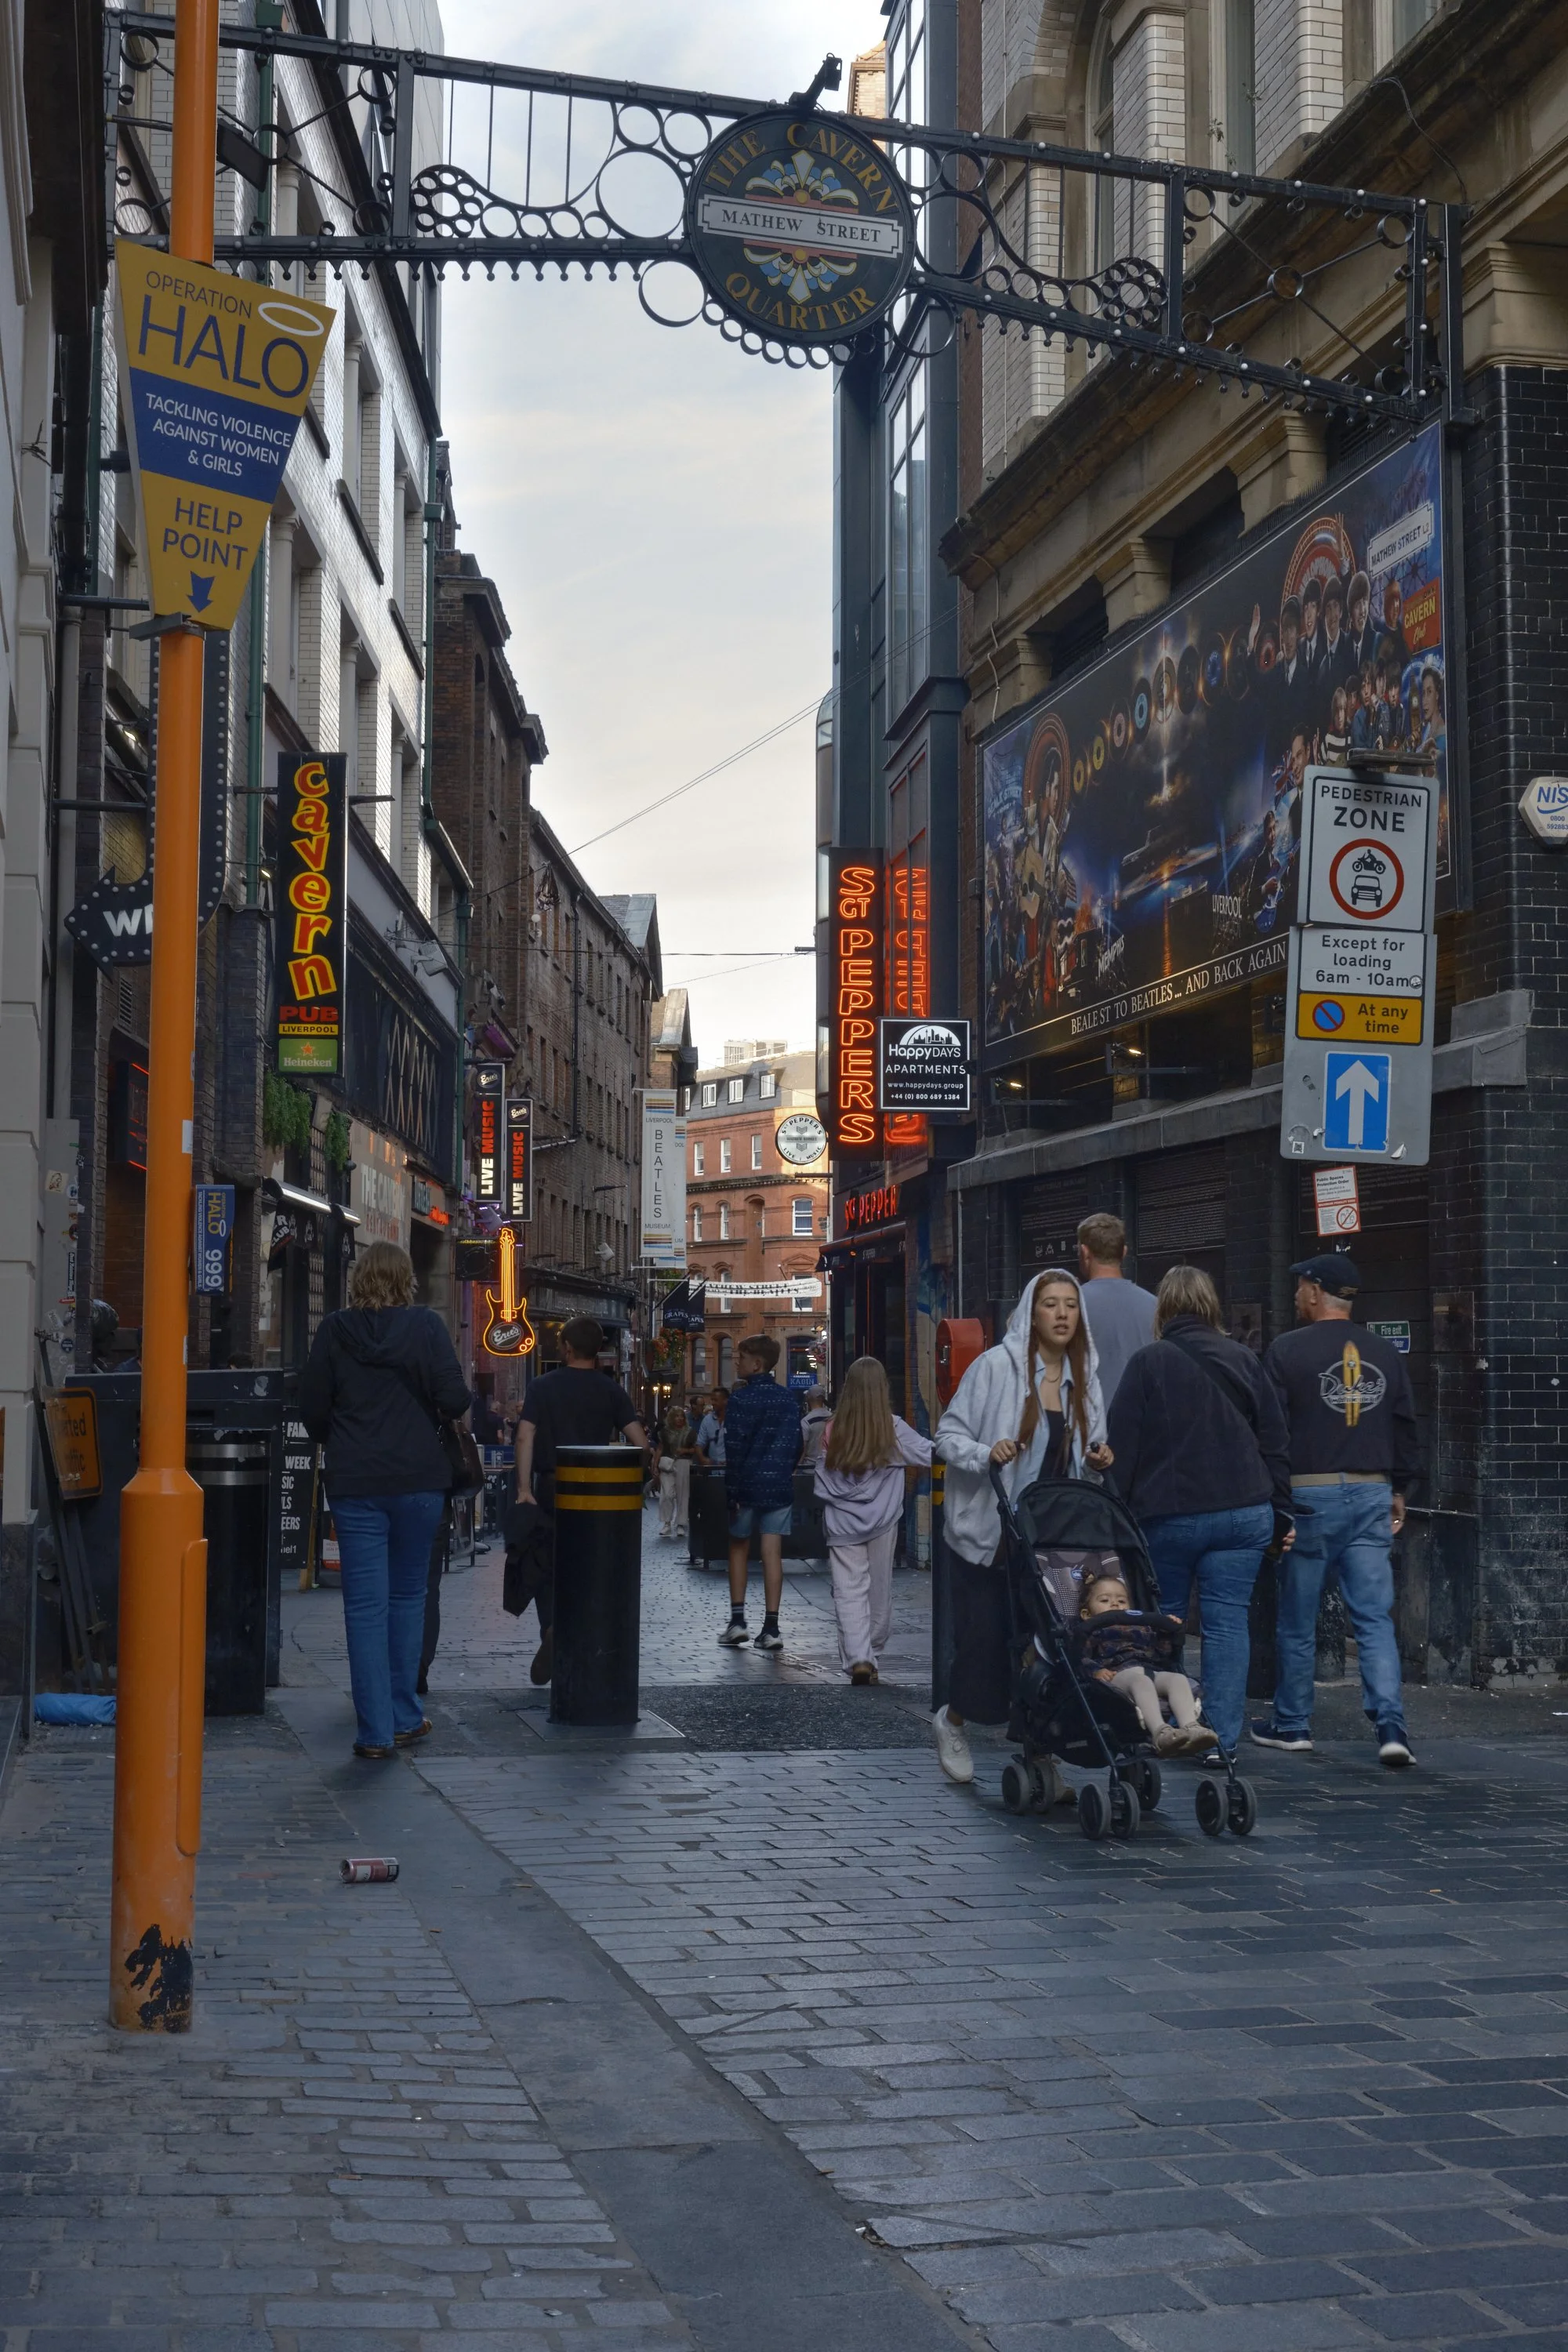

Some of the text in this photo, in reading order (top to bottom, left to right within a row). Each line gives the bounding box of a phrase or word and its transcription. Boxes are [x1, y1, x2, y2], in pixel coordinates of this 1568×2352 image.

[705, 123, 898, 213] THE CAVERN
[722, 209, 880, 243] MATHEW STREET
[146, 270, 252, 318] OPERATION
[725, 273, 877, 330] QUARTER
[139, 294, 309, 398] HALO
[146, 393, 292, 448] TACKLING VIOLENCE
[153, 418, 279, 466] AGAINST WOMEN
[188, 449, 242, 477] & GIRLS
[175, 497, 243, 530] HELP
[162, 528, 248, 570] POINT
[1371, 540, 1396, 567] MATHEW
[1398, 525, 1421, 550] STREET
[1404, 596, 1436, 629] CAVERN
[1321, 785, 1421, 808] PEDESTRIAN
[1334, 806, 1405, 833] ZONE
[1212, 894, 1243, 919] LIVERPOOL
[1322, 935, 1405, 952] Except for
[1334, 953, 1392, 971] loading
[1071, 1011, 1098, 1035] BEALE
[1099, 1006, 1111, 1025] ST
[1113, 1000, 1127, 1019] TO
[1185, 970, 1210, 994] AND
[1214, 956, 1244, 984] BACK
[1247, 941, 1286, 973] AGAIN
[1316, 969, 1349, 984] 6am
[1368, 973, 1409, 987] 10am
[279, 1006, 338, 1022] PUB
[1358, 1004, 1409, 1020] At any
[1365, 1021, 1399, 1033] time
[839, 928, 875, 1143] PEPPERS
[284, 1057, 332, 1066] Heineken
[885, 1064, 966, 1075] APARTMENTS
[789, 1117, 822, 1134] PEPPERS
[481, 1100, 494, 1195] LIVE MUSIC
[783, 1146, 822, 1160] LIVE MUSIC
[513, 1131, 524, 1215] LIVE MUSIC
[654, 1129, 663, 1218] BEATLES
[208, 1192, 220, 1235] HALO
[205, 1249, 223, 1287] 999
[1381, 1325, 1402, 1334] Fire exit
[285, 1456, 311, 1469] WEEK
[281, 1476, 294, 1490] SIC
[281, 1516, 300, 1530] EERS
